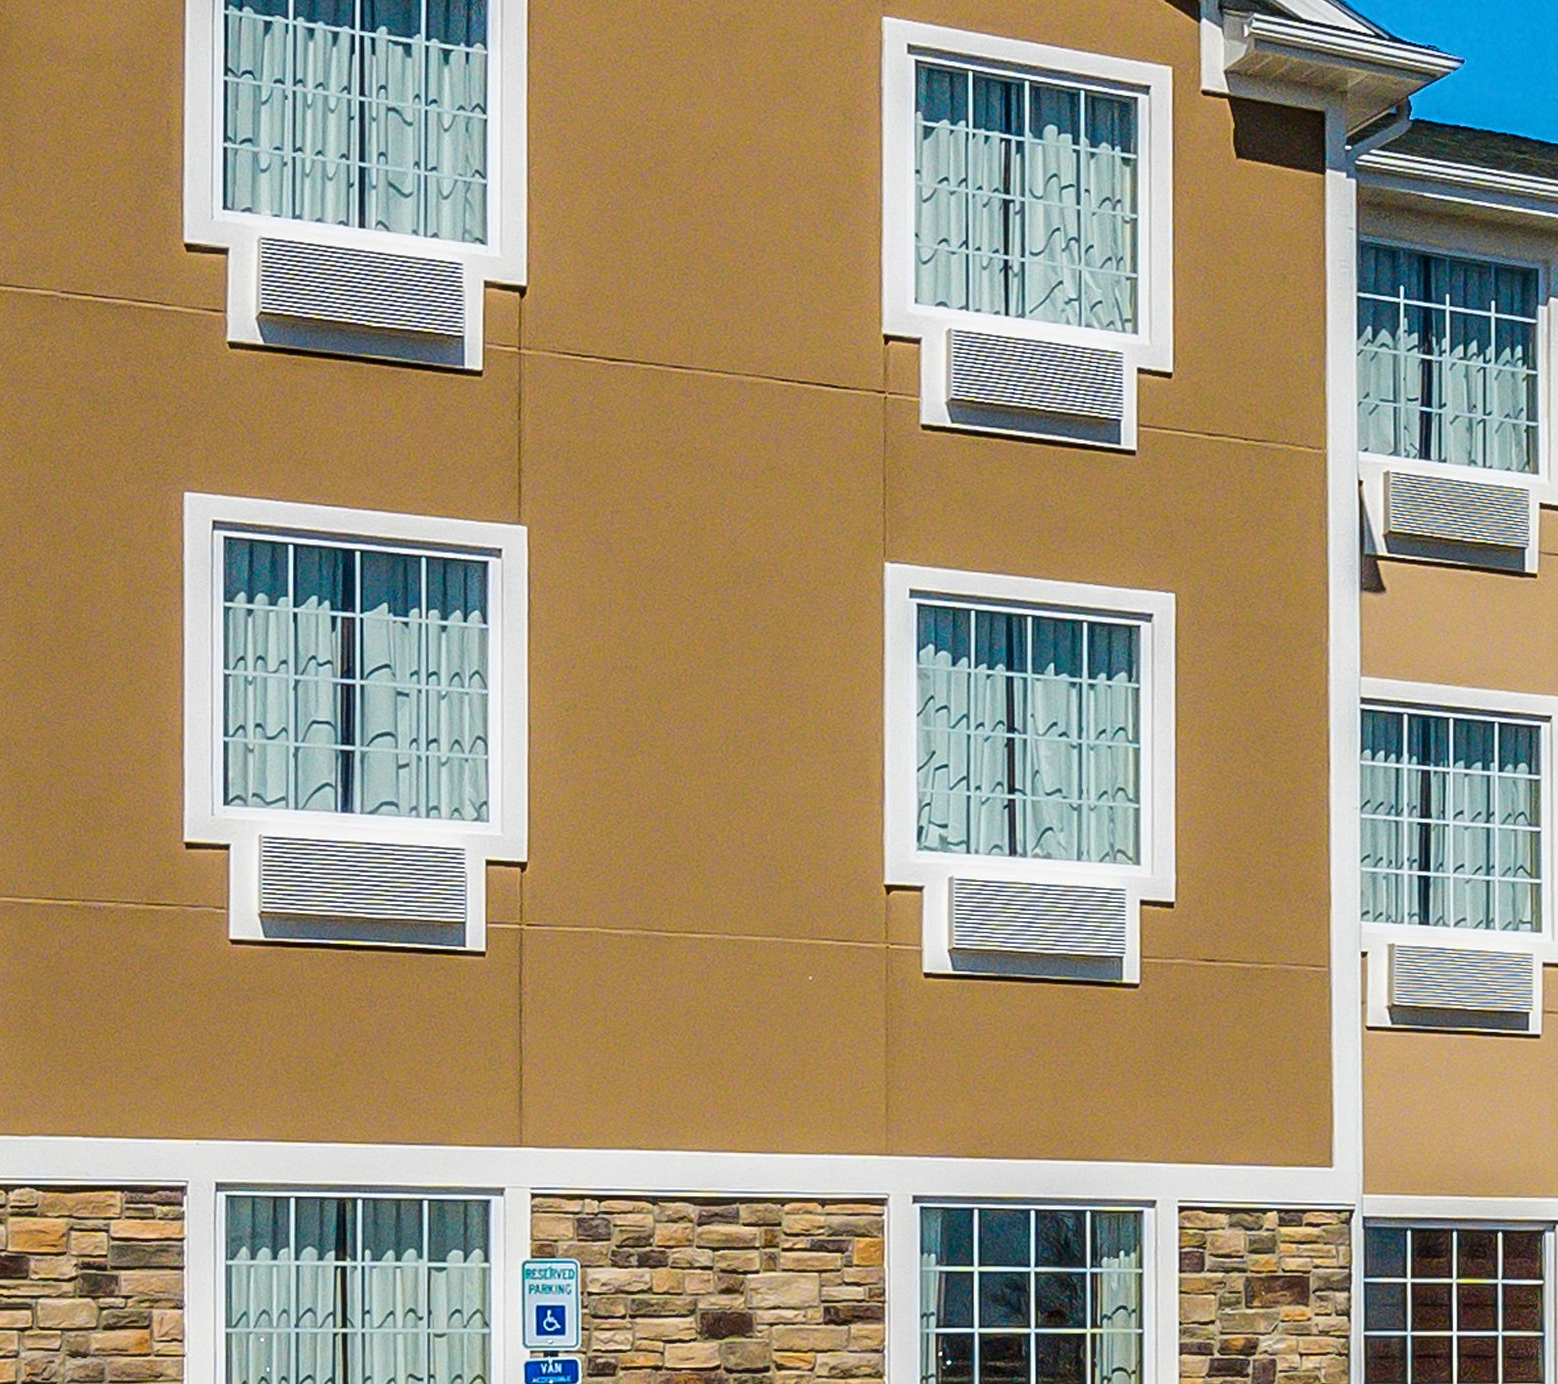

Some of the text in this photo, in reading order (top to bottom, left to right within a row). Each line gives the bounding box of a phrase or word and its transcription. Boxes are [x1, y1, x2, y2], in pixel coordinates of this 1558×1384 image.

[525, 1268, 576, 1280] RESERVED
[528, 1283, 572, 1295] PARKING
[540, 1362, 563, 1375] VAN
